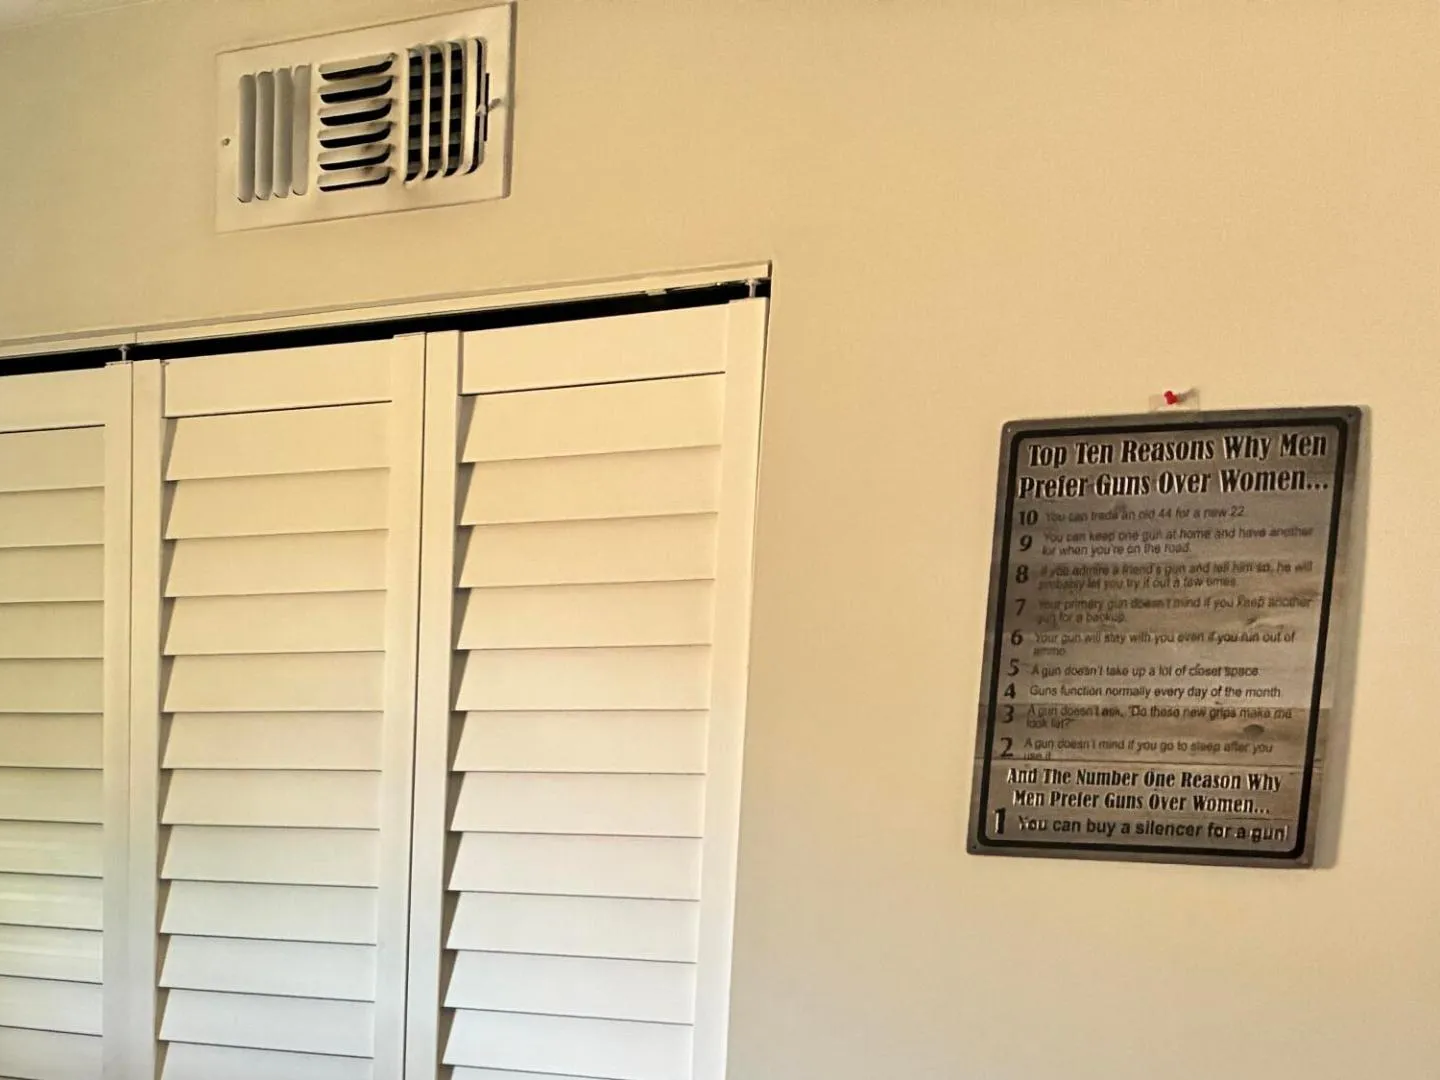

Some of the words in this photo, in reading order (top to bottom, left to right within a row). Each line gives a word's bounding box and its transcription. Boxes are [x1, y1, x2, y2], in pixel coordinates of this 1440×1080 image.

[1029, 444, 1067, 468] Top
[1076, 442, 1113, 464] Ten
[1121, 439, 1215, 463] Reasons
[1223, 435, 1272, 461] Why
[1280, 433, 1327, 457] Men
[1019, 475, 1088, 498] Prefer
[1095, 473, 1150, 496] Guns
[1159, 471, 1211, 494] Over
[1220, 469, 1328, 493] Women...
[1019, 510, 1038, 526] 10
[1045, 511, 1065, 522] You
[1069, 513, 1088, 522] can
[1091, 510, 1118, 521] trade
[1121, 511, 1136, 520] an
[1138, 509, 1156, 520] old
[1175, 507, 1190, 518] for
[1193, 509, 1201, 518] a
[1203, 508, 1227, 518] new
[1019, 534, 1033, 552] 9
[1043, 532, 1062, 543] You
[1066, 533, 1086, 542] can
[1089, 531, 1115, 543] keep
[1118, 532, 1139, 541] one
[1141, 530, 1161, 542] gun
[1165, 530, 1177, 540] at
[1179, 528, 1210, 539] home
[1214, 527, 1235, 539] and
[1239, 526, 1266, 538] have
[1269, 526, 1314, 537] another
[1059, 544, 1088, 556] when
[1091, 543, 1124, 557] you're
[1126, 545, 1141, 554] on
[1143, 543, 1161, 554] the
[1015, 564, 1029, 583] 8
[1112, 566, 1120, 575] a
[1164, 563, 1186, 576] gun
[1188, 562, 1209, 573] and
[1213, 561, 1229, 573] tell
[1232, 560, 1253, 572] him
[1277, 560, 1291, 572] he
[1294, 560, 1313, 572] will
[1087, 579, 1100, 590] let
[1104, 580, 1122, 591] you
[1126, 579, 1139, 591] try
[1143, 578, 1150, 588] it
[1152, 578, 1170, 588] out
[1172, 578, 1180, 588] a
[1183, 577, 1203, 587] few
[1015, 598, 1026, 616] 7
[1063, 599, 1102, 612] primary
[1107, 599, 1127, 611] gun
[1173, 597, 1200, 608] mind
[1203, 596, 1211, 608] if
[1213, 598, 1233, 611] you
[1267, 596, 1312, 608] another
[1060, 612, 1073, 623] for
[1075, 613, 1083, 623] a
[1011, 629, 1023, 646] 6
[1034, 632, 1058, 643] Your
[1060, 632, 1082, 645] gun
[1085, 632, 1101, 643] will
[1104, 632, 1126, 644] stay
[1129, 632, 1150, 643] with
[1154, 633, 1174, 645] you
[1177, 632, 1204, 642] even
[1208, 631, 1216, 642] if
[1216, 633, 1238, 645] you
[1240, 632, 1259, 642] run
[1262, 632, 1281, 642] out
[1283, 631, 1296, 642] of
[1007, 659, 1020, 676] 5
[1030, 664, 1039, 675] A
[1041, 665, 1061, 677] gun
[1063, 664, 1103, 676] doesn't
[1106, 665, 1129, 676] take
[1132, 666, 1146, 677] up
[1148, 666, 1156, 675] a
[1159, 664, 1172, 675] lot
[1174, 664, 1187, 676] of
[1188, 663, 1221, 676] closet
[1004, 682, 1016, 699] 4
[1030, 685, 1057, 696] Guns
[1060, 684, 1102, 696] function
[1105, 686, 1151, 698] normally
[1154, 687, 1185, 698] every
[1187, 686, 1208, 699] day
[1210, 685, 1223, 697] of
[1224, 686, 1242, 697] the
[1002, 704, 1014, 723] 3
[1026, 704, 1035, 715] A
[1037, 706, 1057, 718] gun
[1060, 705, 1099, 717] doesn't
[1150, 706, 1180, 718] these
[1182, 708, 1206, 718] new
[1210, 707, 1237, 721] grips
[1239, 707, 1270, 718] make
[1273, 708, 1292, 719] me
[1025, 718, 1047, 728] look
[1000, 737, 1014, 757] 2
[1024, 738, 1032, 748] A
[1034, 739, 1054, 751] gun
[1057, 738, 1096, 749] doesn't
[1098, 738, 1124, 750] mind
[1127, 739, 1135, 750] if
[1136, 740, 1157, 752] you
[1160, 742, 1174, 753] go
[1177, 741, 1187, 751] to
[1190, 741, 1220, 753] sleep
[1223, 741, 1250, 753] after
[1252, 743, 1273, 754] you
[1023, 751, 1043, 760] use
[1007, 768, 1037, 784] And
[1043, 768, 1071, 785] The
[1077, 769, 1139, 786] Number
[1144, 770, 1175, 787] One
[1181, 772, 1241, 789] Reason
[1247, 773, 1282, 792] Why
[1013, 789, 1044, 806] Men
[1049, 792, 1099, 808] Prefer
[1104, 792, 1143, 809] Guns
[1149, 794, 1187, 811] Over
[1193, 795, 1270, 814] Women...
[993, 807, 1006, 834] 1
[1018, 816, 1047, 831] You
[1052, 820, 1081, 833] can
[1087, 818, 1116, 836] buy
[1120, 822, 1131, 834] a
[1135, 820, 1203, 837] silencer
[1208, 822, 1232, 838] for
[1235, 827, 1246, 839] a
